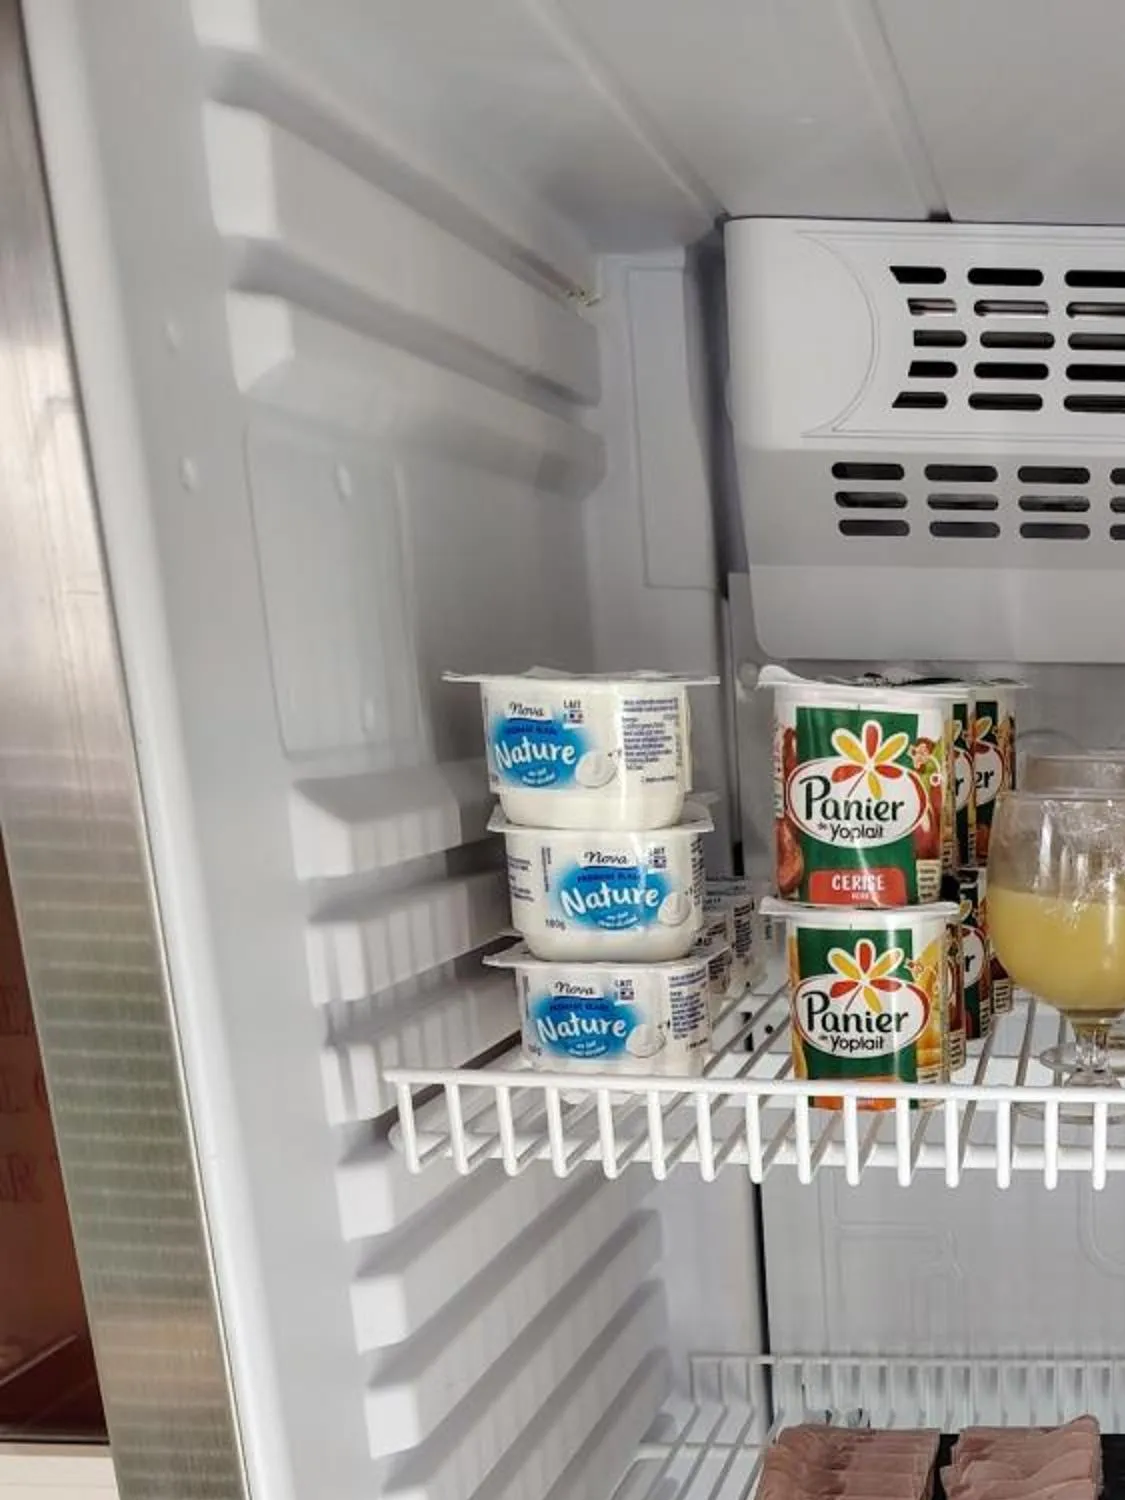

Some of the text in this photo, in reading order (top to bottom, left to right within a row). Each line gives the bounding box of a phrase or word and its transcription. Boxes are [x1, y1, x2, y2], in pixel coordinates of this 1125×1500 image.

[508, 701, 546, 717] Nova
[494, 735, 577, 769] Nature
[799, 775, 905, 821] Panier
[830, 823, 884, 842] Yoplait
[583, 851, 629, 866] Nova
[560, 881, 660, 917] Nature
[554, 980, 596, 996] Nova
[801, 989, 909, 1033] Panier
[536, 1011, 628, 1044] Nature
[830, 1035, 884, 1053] Yoplait
